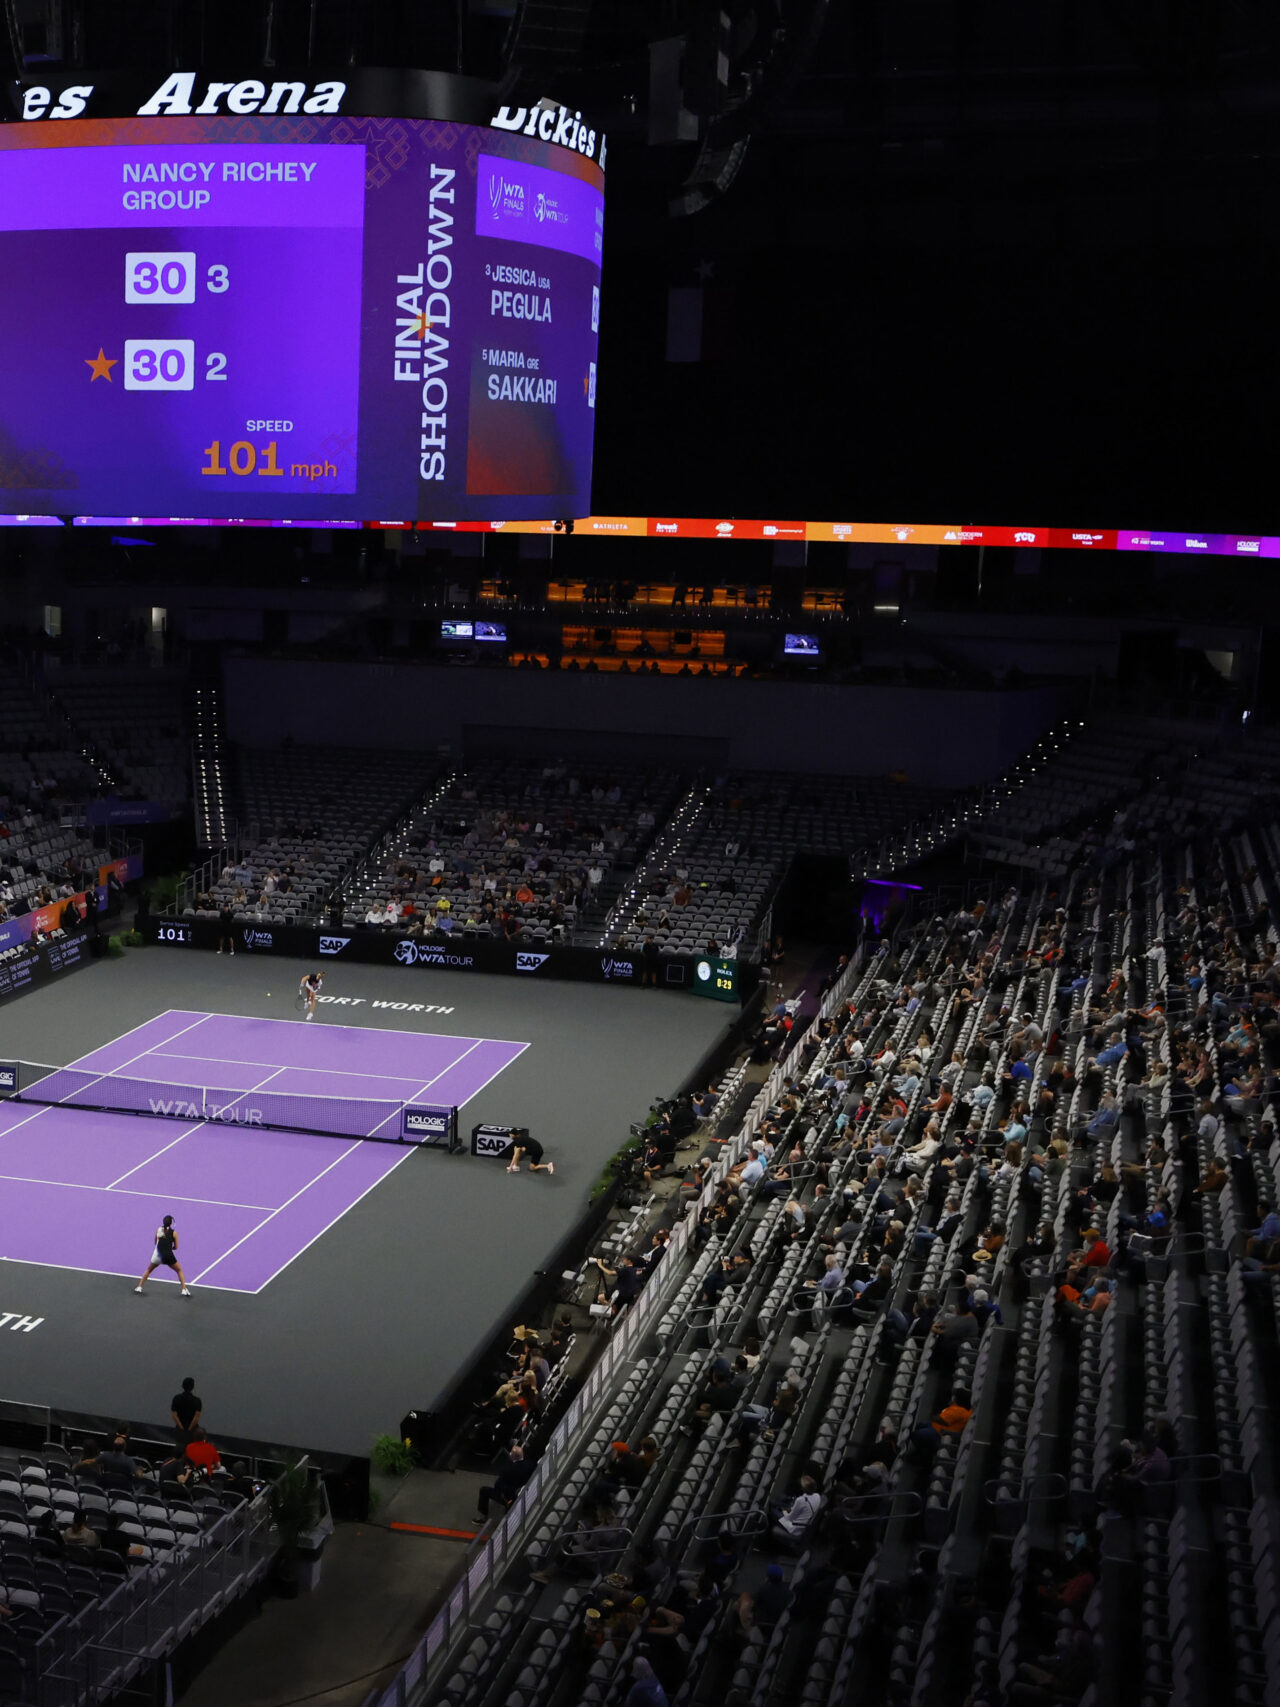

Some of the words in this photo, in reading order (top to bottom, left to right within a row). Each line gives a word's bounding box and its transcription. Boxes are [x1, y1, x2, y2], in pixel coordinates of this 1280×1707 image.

[136, 72, 346, 115] Arena
[122, 162, 216, 183] NANCY
[222, 162, 317, 182] RICHEY
[122, 190, 210, 210] GROUP
[133, 261, 187, 295] 30
[206, 264, 230, 293] 3
[492, 265, 537, 287] JESSICA
[538, 278, 551, 290] USA
[490, 290, 552, 323] PEGULA
[394, 263, 424, 382] FINAL
[420, 163, 456, 480] SHOWDOWN
[132, 349, 186, 382] 30
[205, 352, 228, 381] 2
[488, 349, 525, 369] MARIA
[527, 357, 539, 370] GRE
[488, 374, 557, 404] SAKKARI
[246, 420, 294, 432] SPEED
[201, 440, 284, 476] 101
[290, 460, 337, 481] mph
[1014, 532, 1035, 543] TCU
[157, 928, 185, 941] 101
[320, 939, 343, 951] SAP
[419, 945, 446, 953] HOLOGIC
[517, 955, 542, 967] SAP
[613, 961, 633, 969] WTA
[716, 978, 732, 990] 0:29
[372, 1000, 455, 1014] WORTH
[148, 1098, 199, 1119] WTA
[406, 1114, 446, 1126] HOLOGIC
[477, 1137, 506, 1152] SAP
